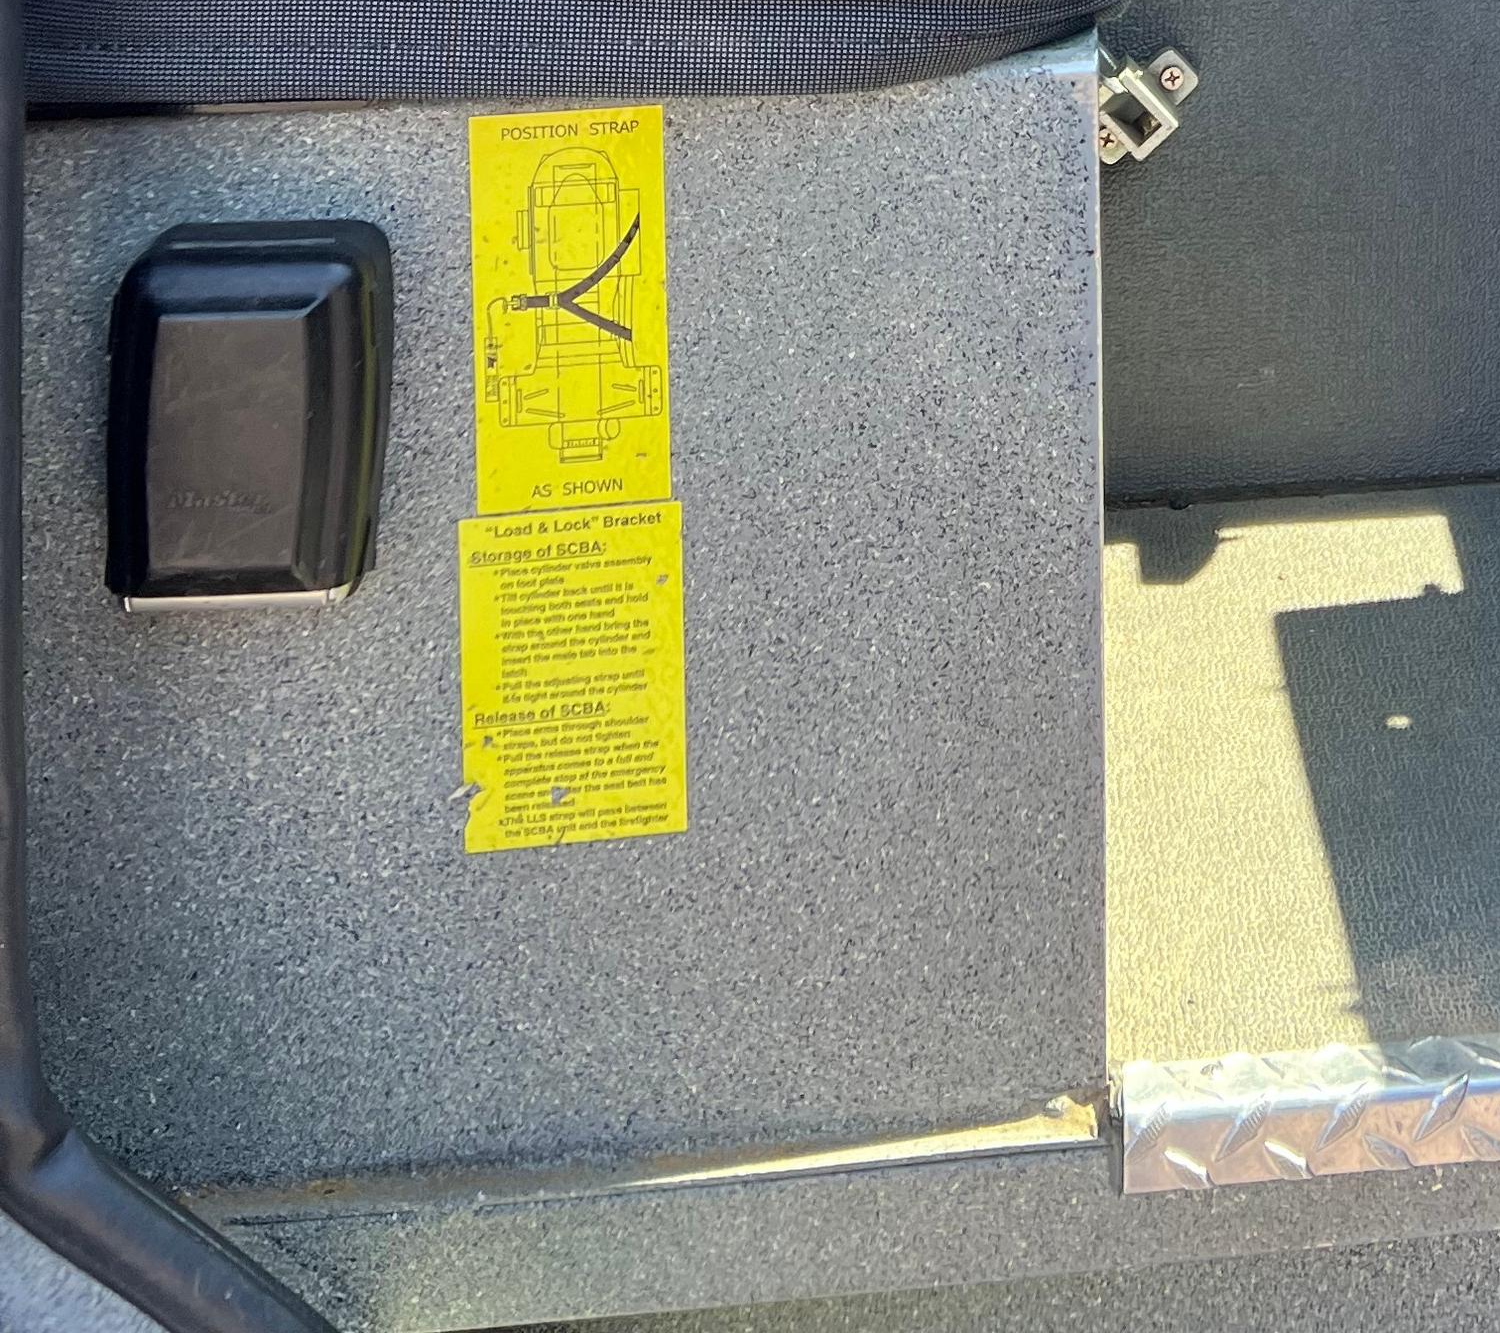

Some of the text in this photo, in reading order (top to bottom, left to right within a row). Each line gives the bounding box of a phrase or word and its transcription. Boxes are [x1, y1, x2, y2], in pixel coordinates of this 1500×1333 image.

[500, 120, 640, 142] POSITION STRAP
[531, 478, 624, 500] AS SHOWN
[537, 522, 549, 534] &
[602, 509, 662, 528] Bracket
[470, 538, 607, 566] Storage of SCBA:
[499, 554, 652, 576] Place cylinder valve assembly
[501, 593, 516, 602] Tilt
[519, 588, 560, 602] cylinder
[563, 586, 587, 596] back
[589, 583, 613, 593] until
[615, 582, 622, 590] it
[516, 578, 536, 587] foot
[539, 576, 564, 587] plate
[501, 603, 545, 616] touching
[548, 600, 571, 611] both
[604, 595, 623, 605] and
[626, 593, 648, 602] hold
[500, 608, 614, 628] in place with one hand
[503, 617, 649, 639] With the other hand bring the
[502, 630, 651, 654] strap around the cylinder and
[502, 644, 637, 666] insert the male tab into the
[502, 669, 646, 691] Pull the adjusting strap until
[523, 691, 547, 704] tight
[549, 687, 585, 699] around
[588, 685, 604, 695] the
[606, 681, 648, 696] cylinder
[475, 699, 611, 725] Release of SCBA:
[502, 713, 649, 737] Place arms through shoulder
[540, 738, 557, 746] but
[559, 736, 572, 744] do
[575, 734, 593, 743] not
[595, 730, 630, 742] tighten
[503, 738, 659, 762] Pull the release strap when the
[503, 762, 555, 777] apparatus
[557, 760, 591, 770] comes
[593, 757, 604, 766] to
[615, 754, 632, 764] full
[633, 751, 654, 762] and
[503, 765, 668, 789] complete stop at the emergency
[504, 790, 535, 800] scene
[584, 782, 601, 792] the
[602, 780, 624, 791] seat
[627, 778, 646, 788] belt
[648, 776, 667, 786] has
[504, 802, 529, 813] been
[548, 811, 574, 822] strap
[577, 808, 595, 818] will
[597, 807, 623, 817] pass
[624, 800, 667, 813] between
[504, 828, 521, 838] the
[523, 824, 554, 836] SCBA
[578, 820, 598, 830] and
[599, 818, 617, 828] the
[618, 812, 668, 827] firefighter
